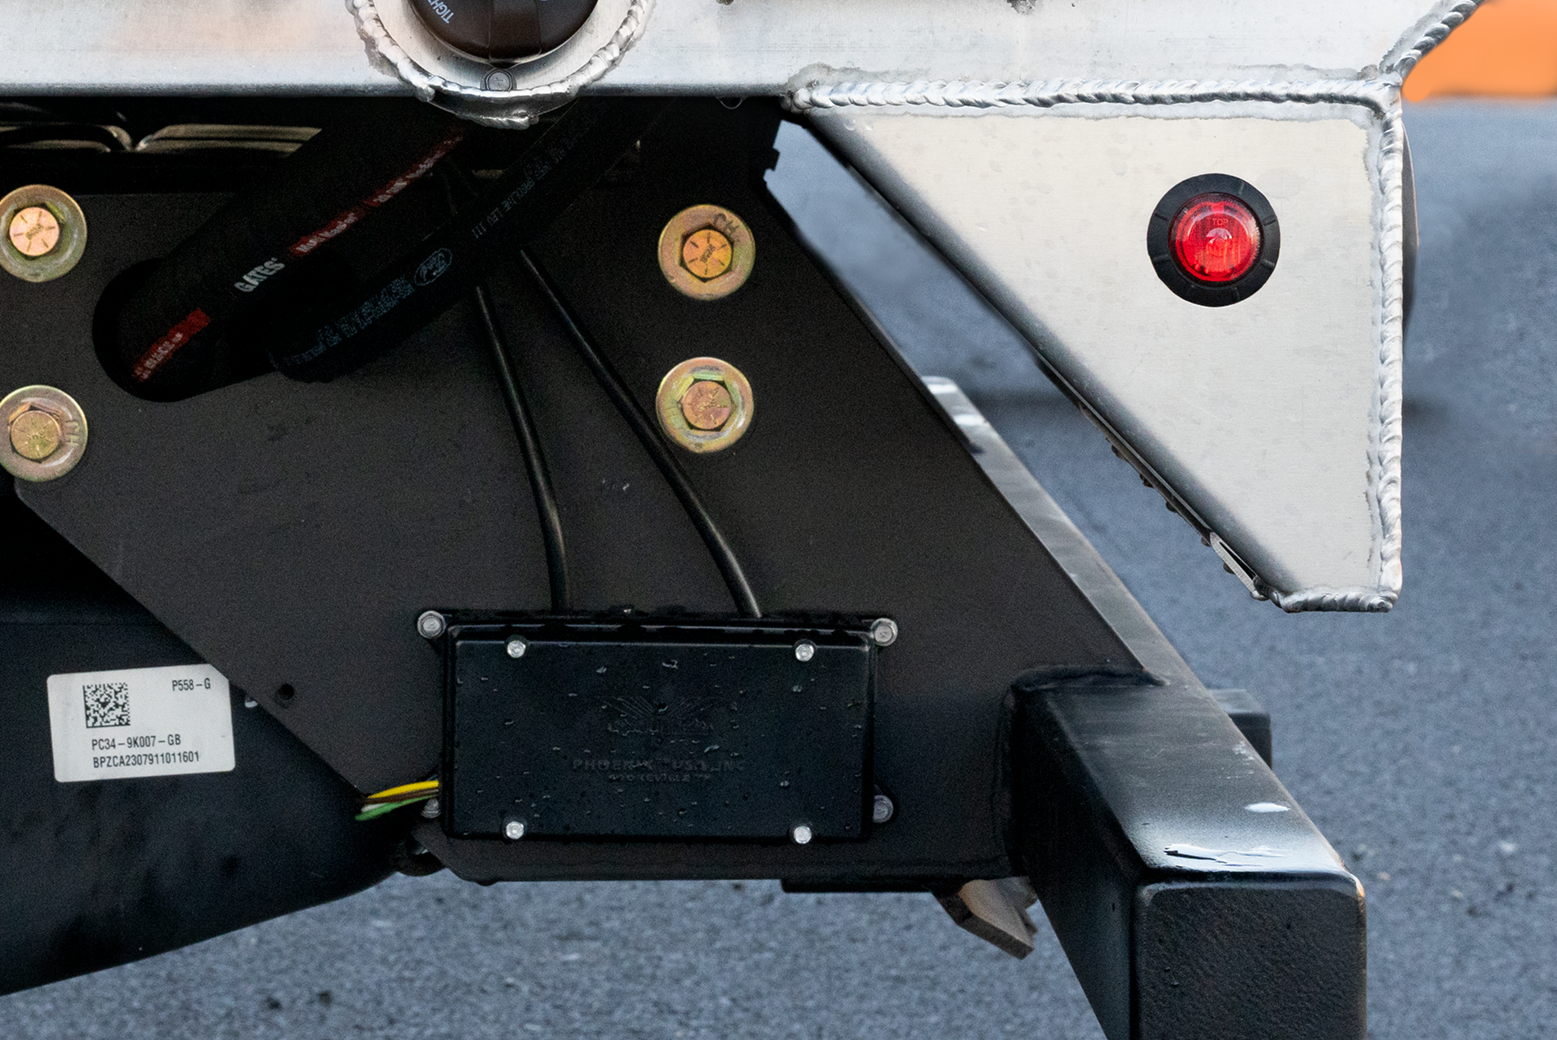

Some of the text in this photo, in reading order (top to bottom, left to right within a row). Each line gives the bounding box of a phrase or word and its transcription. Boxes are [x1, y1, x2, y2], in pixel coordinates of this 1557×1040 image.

[1211, 217, 1229, 226] TOP
[234, 258, 286, 293] GATES
[93, 750, 200, 769] BPZCA2307911011601
